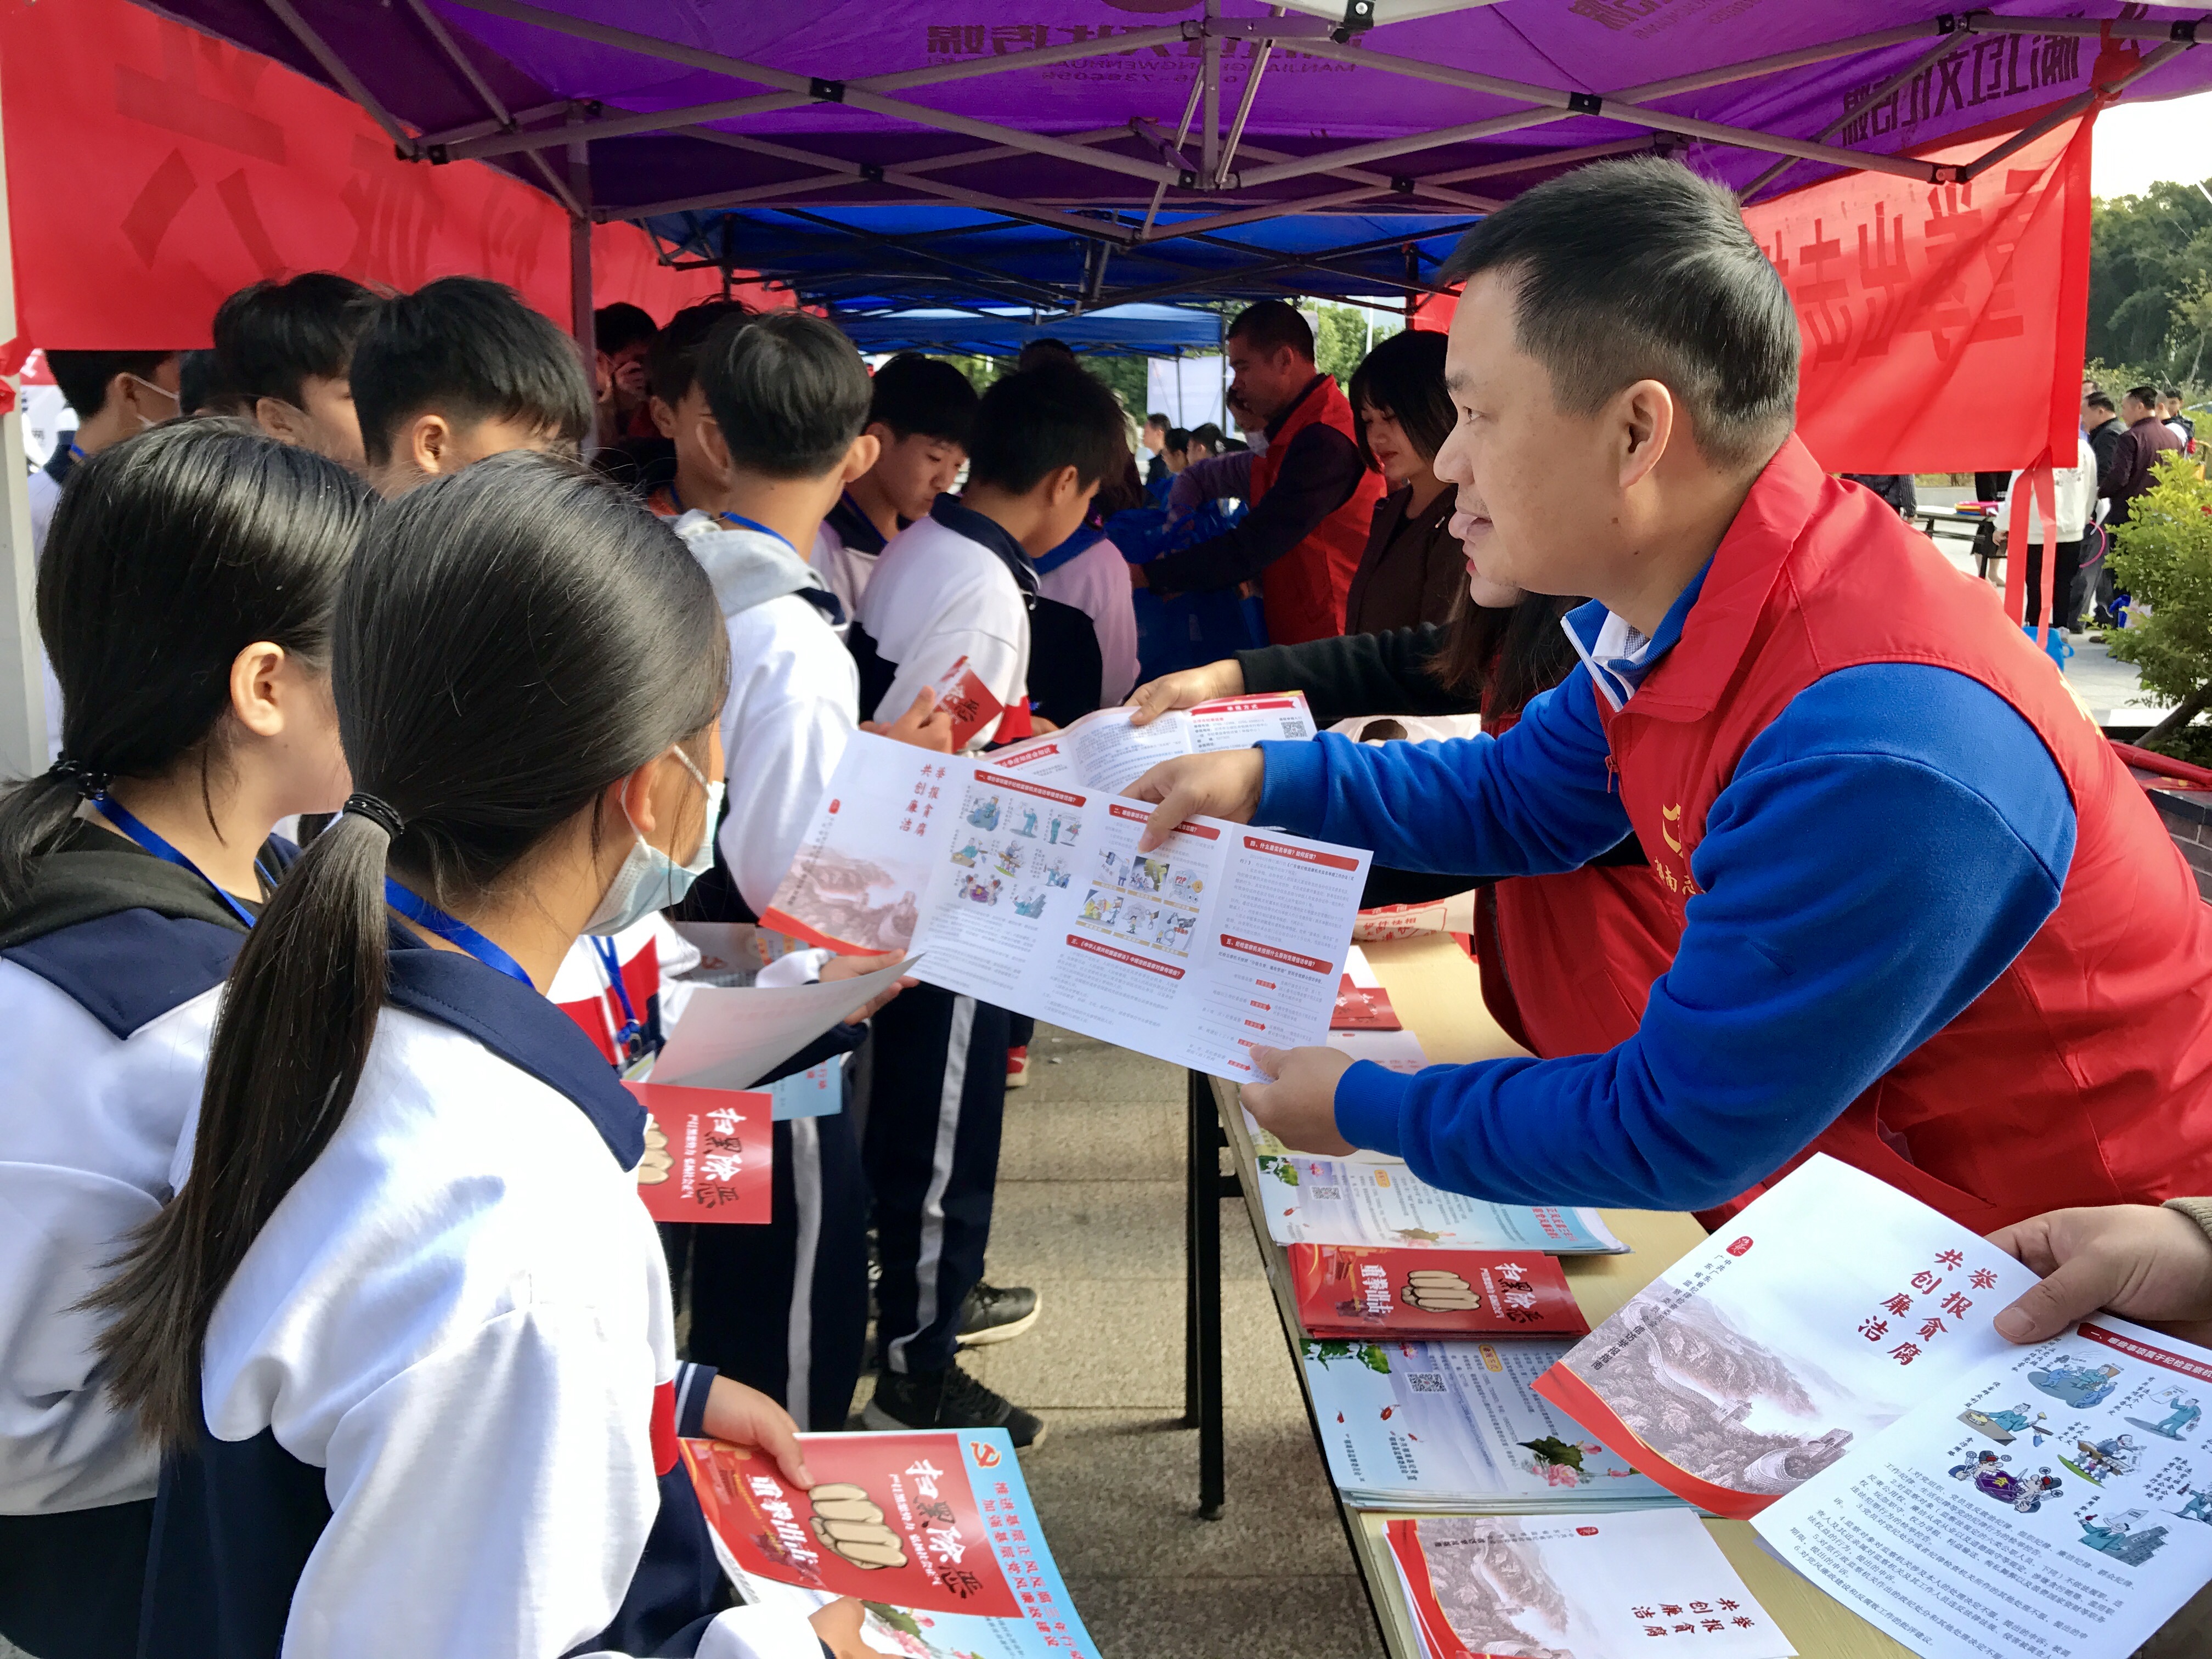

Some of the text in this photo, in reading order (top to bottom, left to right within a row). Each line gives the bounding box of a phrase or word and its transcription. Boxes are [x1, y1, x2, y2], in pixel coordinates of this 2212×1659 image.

[900, 764, 933, 832] 共创廉洁
[915, 766, 947, 837] 举报贪腐
[1175, 876, 1187, 885] P2P
[696, 1107, 747, 1208] 扫黑除恶
[1359, 1264, 1395, 1315] 重拳出击
[1494, 1262, 1544, 1323] 扫黑除恶
[1641, 1253, 1724, 1325] 广东省监察委员会
[1661, 1259, 1732, 1333] 中共广东省纪律检查委员会
[1858, 1248, 1964, 1342] 共创廉洁
[1887, 1268, 1999, 1366] 举报贪腐
[1591, 1324, 1643, 1371] 信访举报指南
[905, 1458, 984, 1599] 扫黑除恶
[1850, 1485, 1933, 1545] 违法犯罪行为的检举控告。
[982, 1498, 1060, 1647] 加强基层党风廉政建设
[1631, 1597, 1741, 1620] 共创廉洁
[1644, 1615, 1756, 1638] 举报贪腐
